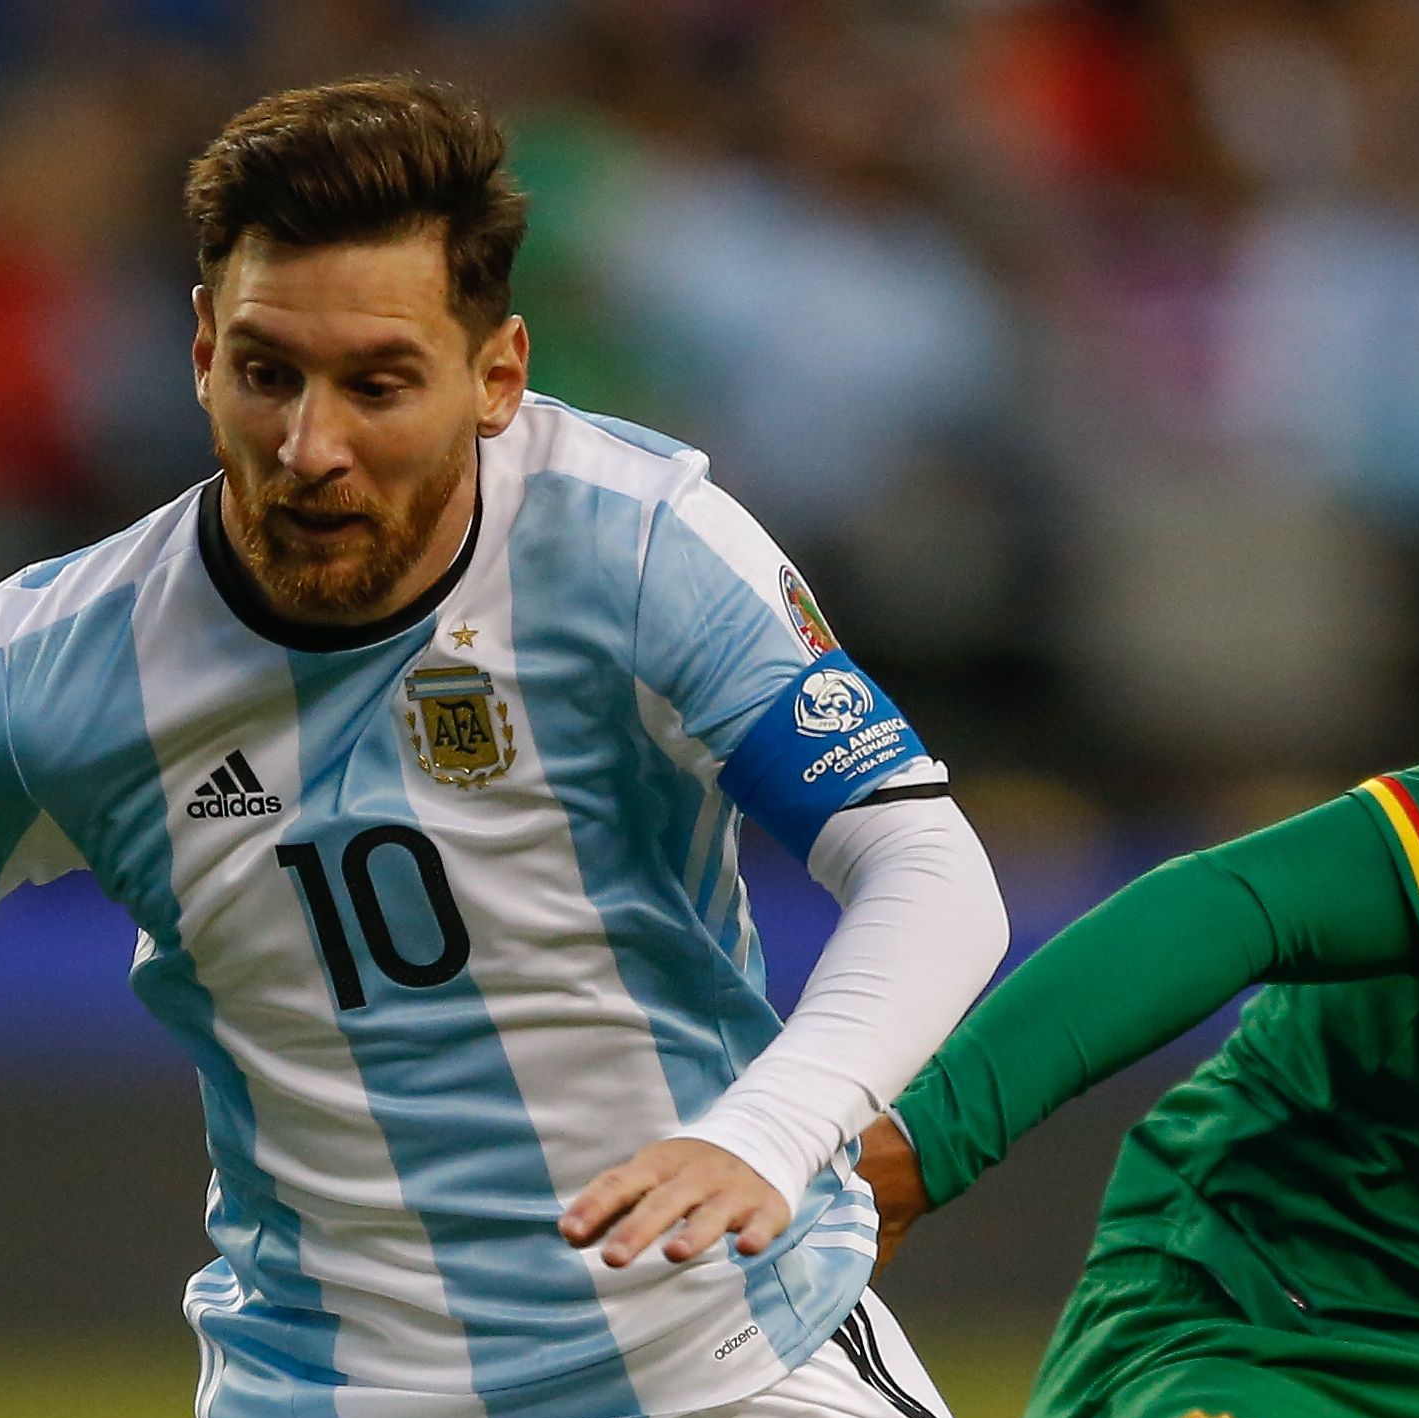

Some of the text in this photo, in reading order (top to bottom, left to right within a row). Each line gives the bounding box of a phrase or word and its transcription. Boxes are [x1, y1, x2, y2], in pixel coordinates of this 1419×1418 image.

[434, 701, 490, 755] AFA
[803, 745, 849, 783] COPA
[833, 732, 900, 774] CENTENARIO
[855, 747, 897, 774] USA 2016
[186, 792, 283, 819] adidas
[274, 824, 471, 1011] 10
[713, 1324, 759, 1361] adizero
